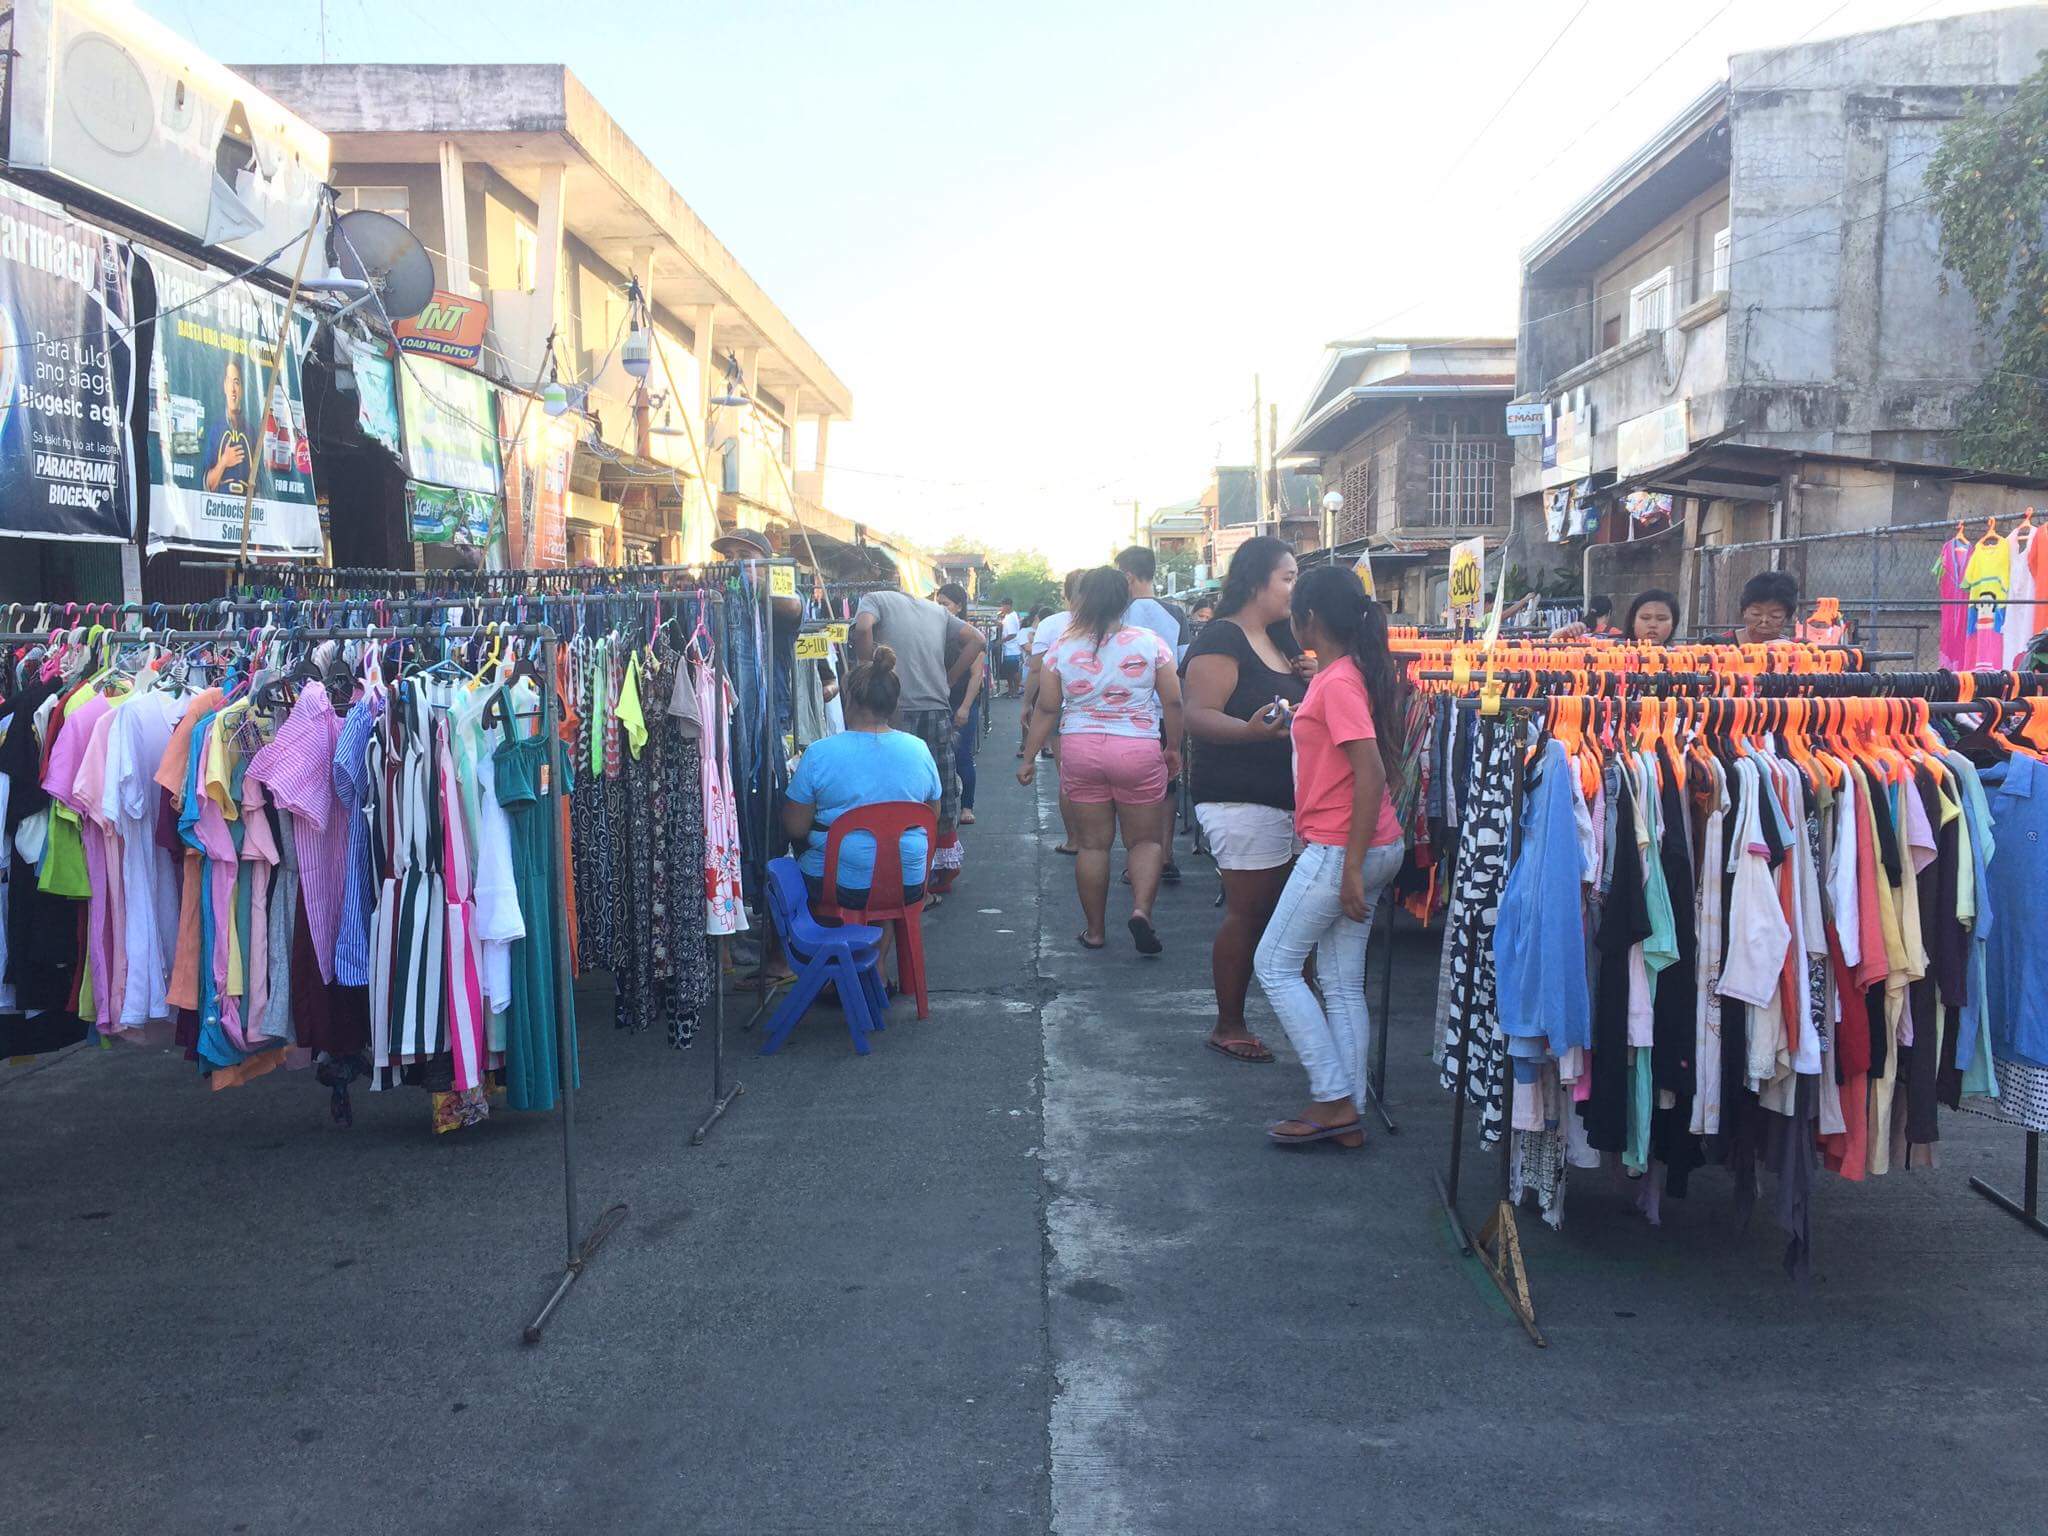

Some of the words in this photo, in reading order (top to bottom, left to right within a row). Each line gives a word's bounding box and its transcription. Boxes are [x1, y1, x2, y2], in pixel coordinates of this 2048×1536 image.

[416, 302, 472, 332] TNT
[36, 331, 69, 360] Para
[401, 338, 426, 348] LOAD
[426, 341, 440, 350] NA
[442, 344, 474, 358] DITO!
[36, 361, 64, 387] ang
[69, 367, 114, 395] alaga
[19, 384, 83, 418] Biogesic
[33, 431, 43, 443] Sa
[44, 434, 61, 446] sakit
[85, 441, 95, 452] at
[36, 454, 116, 484] PARACETAMOL
[275, 479, 288, 492] FOR
[206, 498, 264, 521] Carbocisine
[222, 523, 253, 540] Solmx
